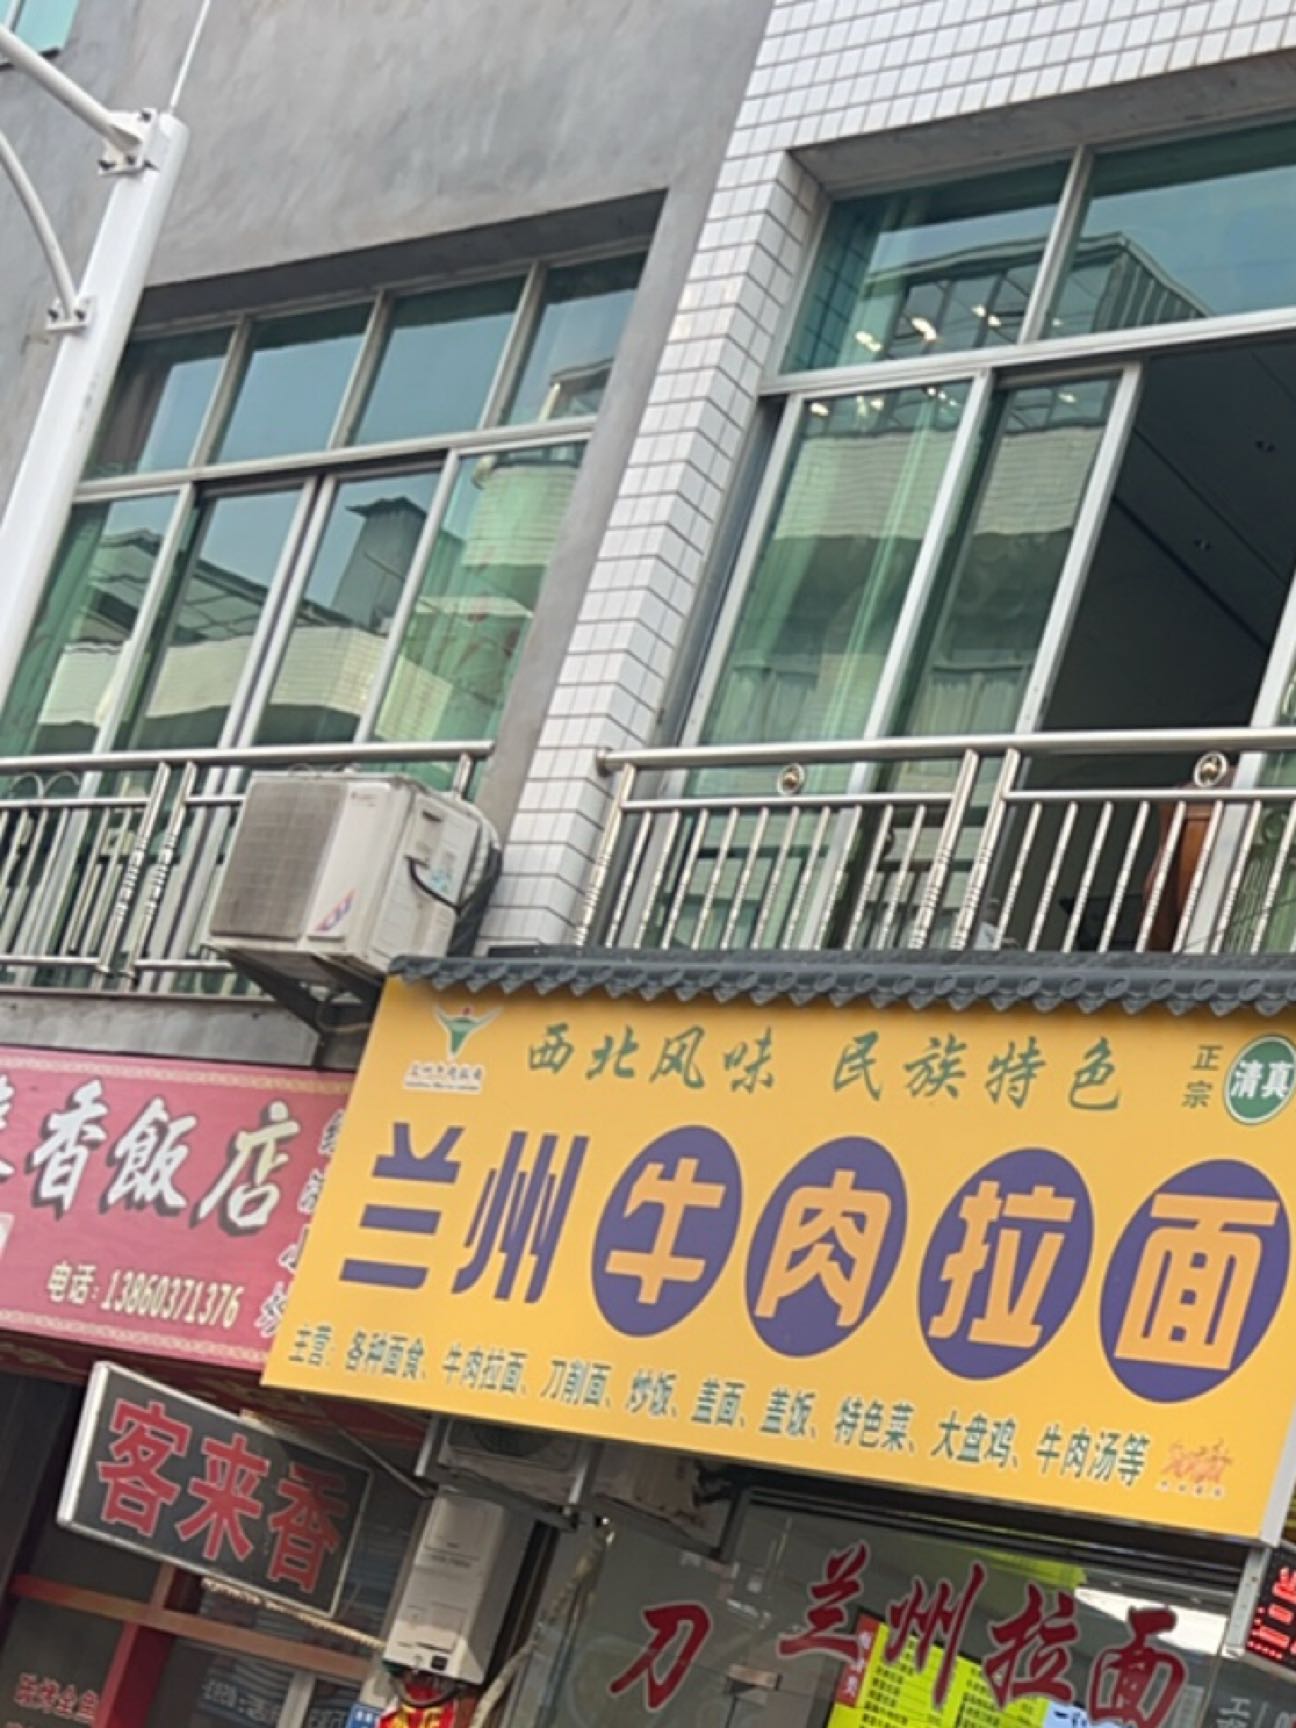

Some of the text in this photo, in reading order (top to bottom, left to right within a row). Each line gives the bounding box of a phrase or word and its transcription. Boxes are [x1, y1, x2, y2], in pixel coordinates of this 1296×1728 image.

[528, 1021, 1121, 1111] 西北风味 民族特色
[1181, 1043, 1224, 1109] 正宗
[1229, 1059, 1295, 1102] 清真
[339, 1123, 1279, 1371] 兰州牛肉拉面
[96, 1398, 349, 1593] 客来香
